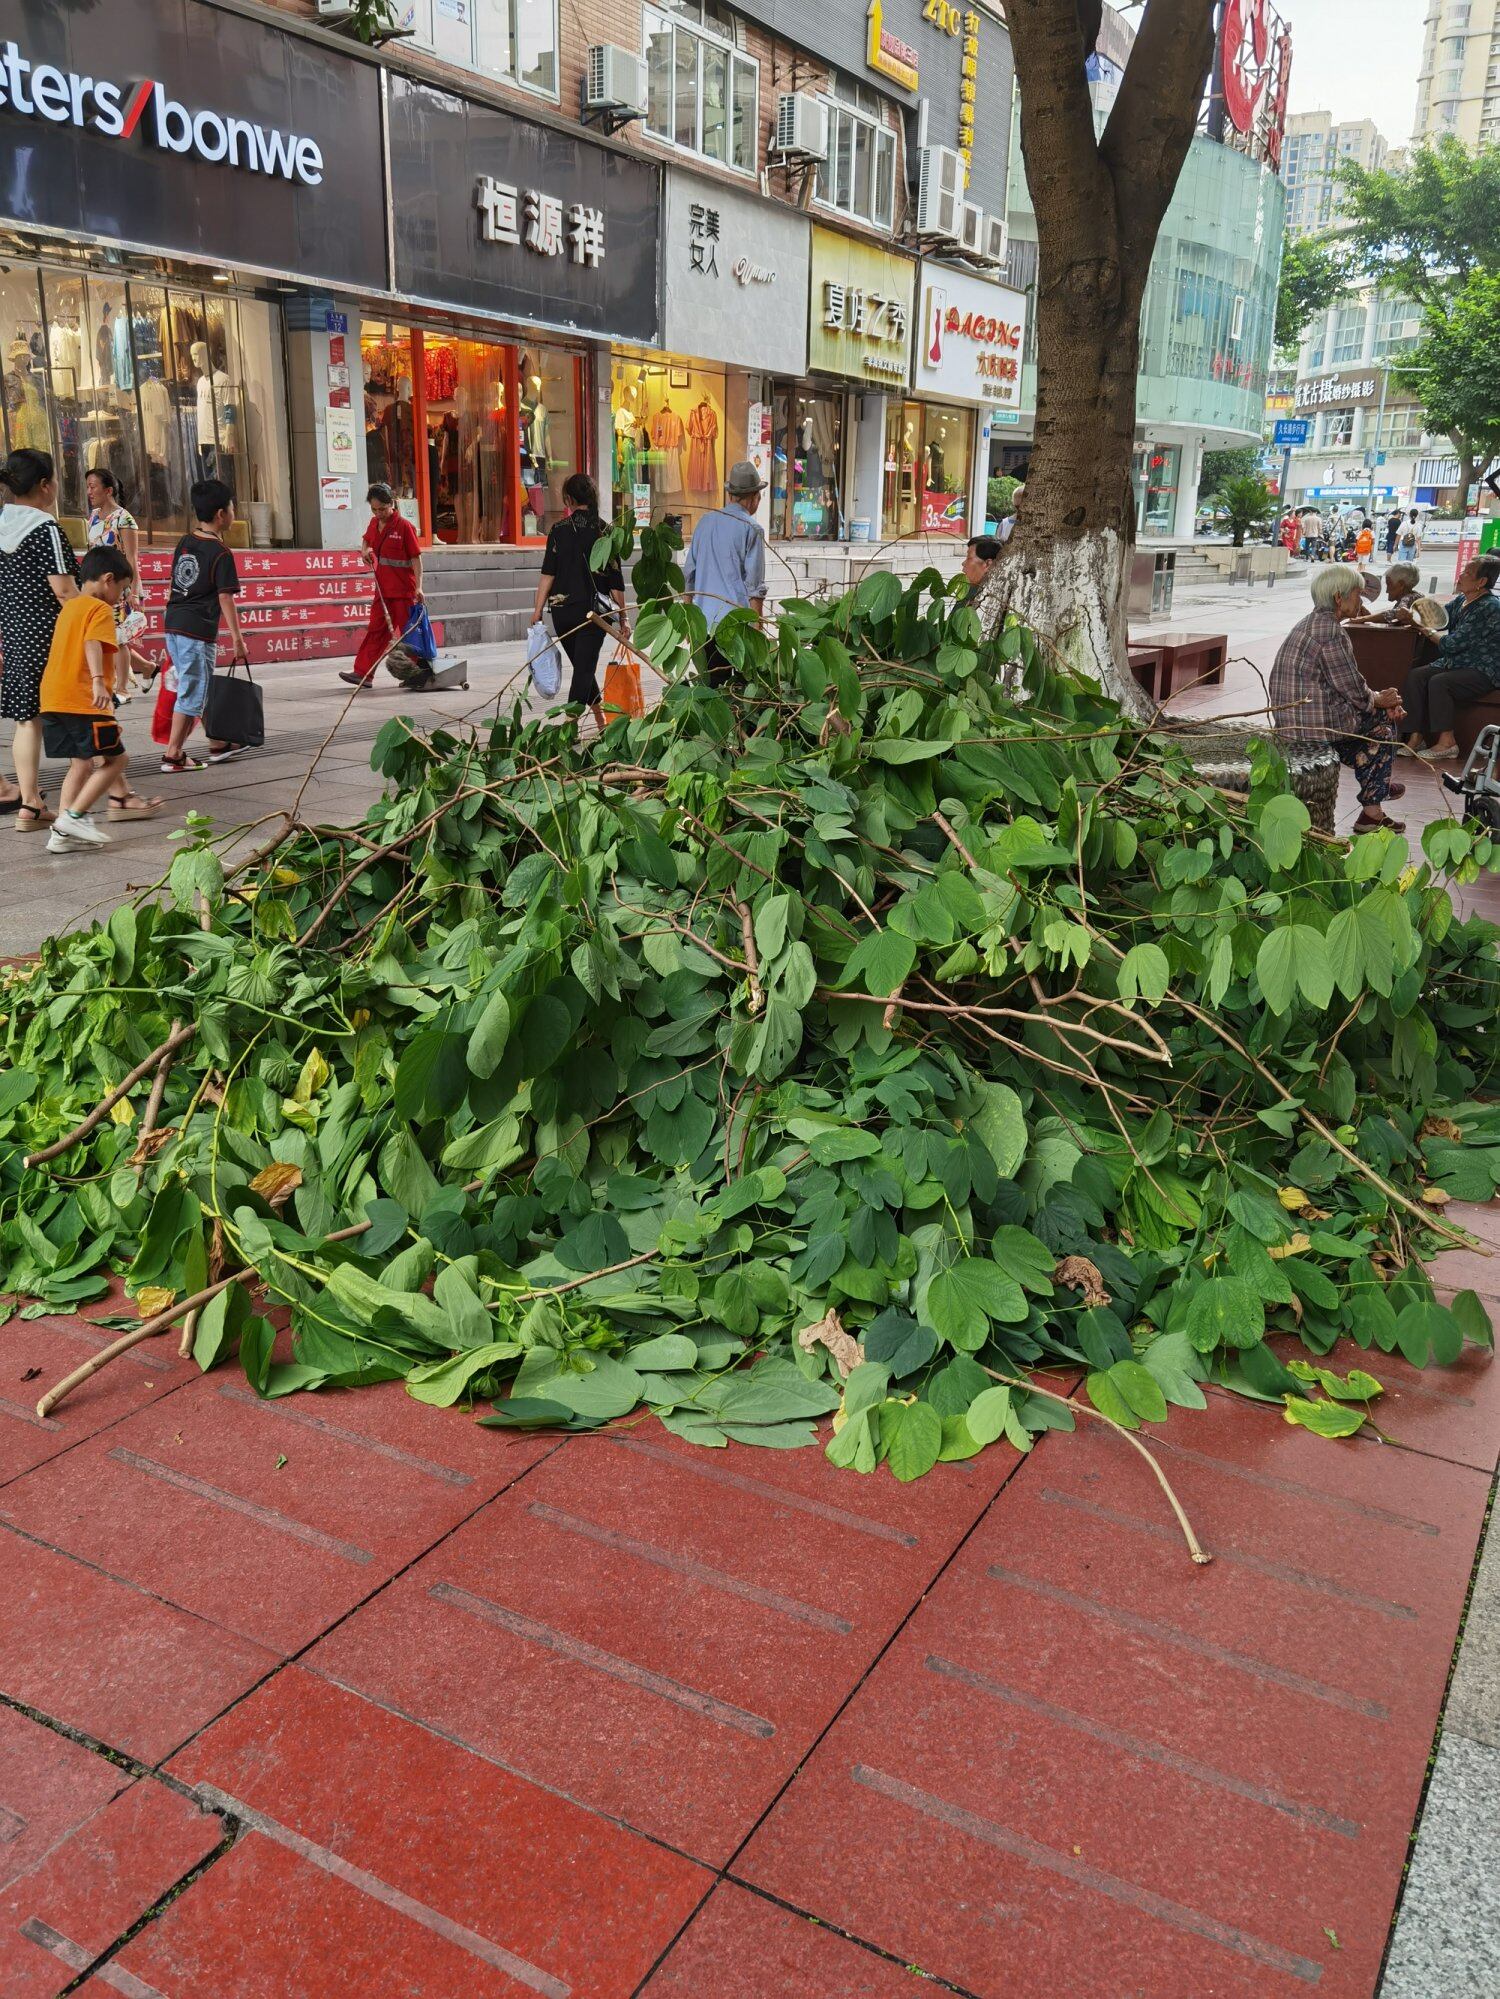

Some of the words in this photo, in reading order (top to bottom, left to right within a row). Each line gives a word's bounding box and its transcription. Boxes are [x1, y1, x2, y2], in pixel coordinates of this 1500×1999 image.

[0, 41, 324, 185] ters/bonwe
[479, 176, 605, 268] 恒源祥
[690, 204, 719, 241] 完美
[690, 239, 719, 278] 女人
[824, 280, 907, 343] 夏娃之秀
[244, 559, 278, 570] 买一送一
[305, 556, 334, 569] SALE
[256, 586, 291, 597] 买一送一
[319, 582, 347, 595] SALE
[240, 609, 272, 623] SALE
[281, 609, 316, 620] 买一送一
[343, 603, 371, 618] SALE
[267, 637, 298, 652] SALE
[304, 638, 338, 649] 买一送一
